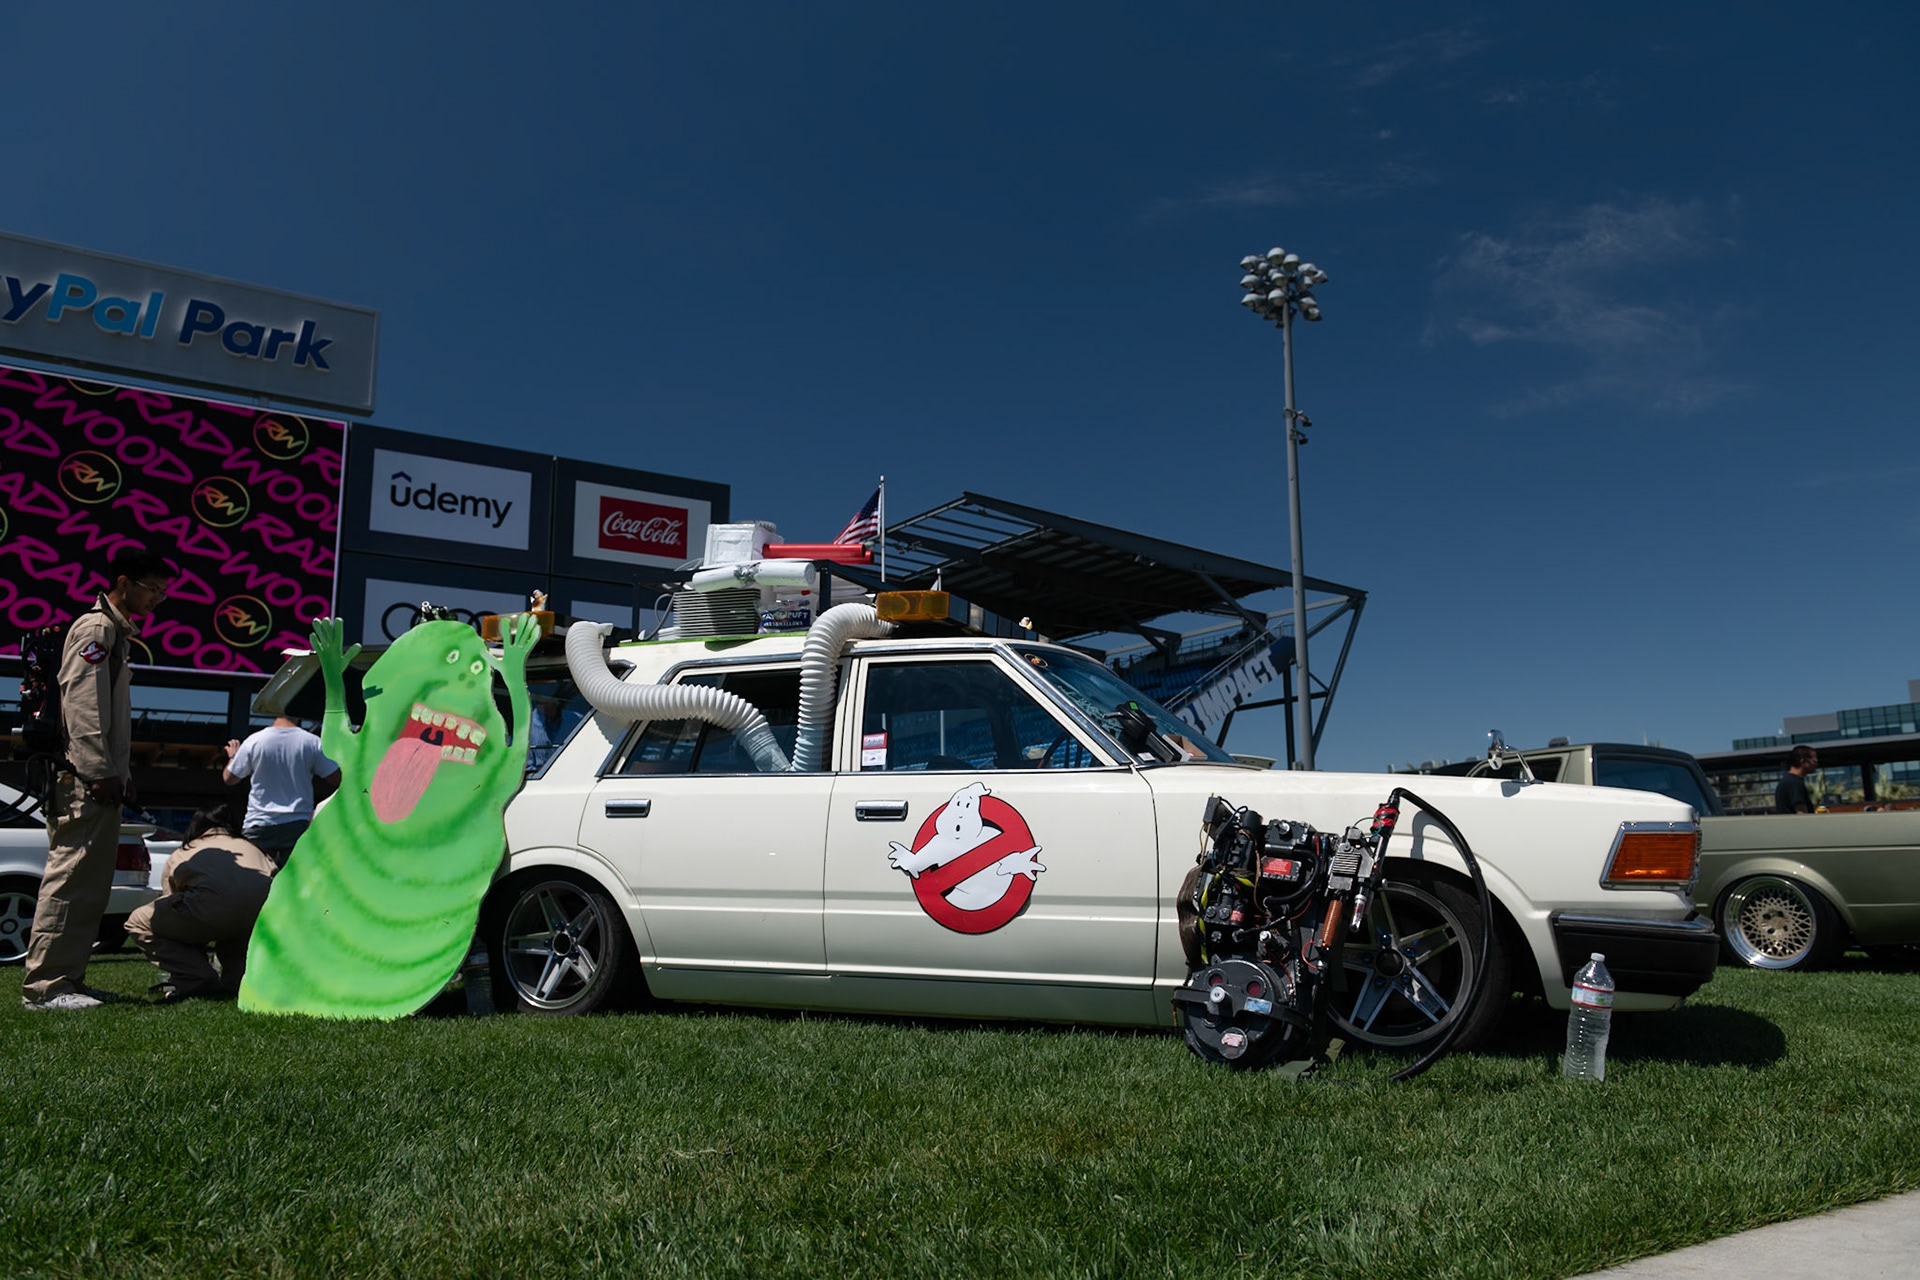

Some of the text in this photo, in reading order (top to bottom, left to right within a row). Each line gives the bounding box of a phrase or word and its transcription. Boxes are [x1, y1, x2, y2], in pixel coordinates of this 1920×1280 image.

[0, 273, 333, 371] yPal Park
[112, 488, 331, 624] RADWOO
[603, 511, 683, 545] Coca-Cola
[1193, 647, 1280, 729] IMPACT
